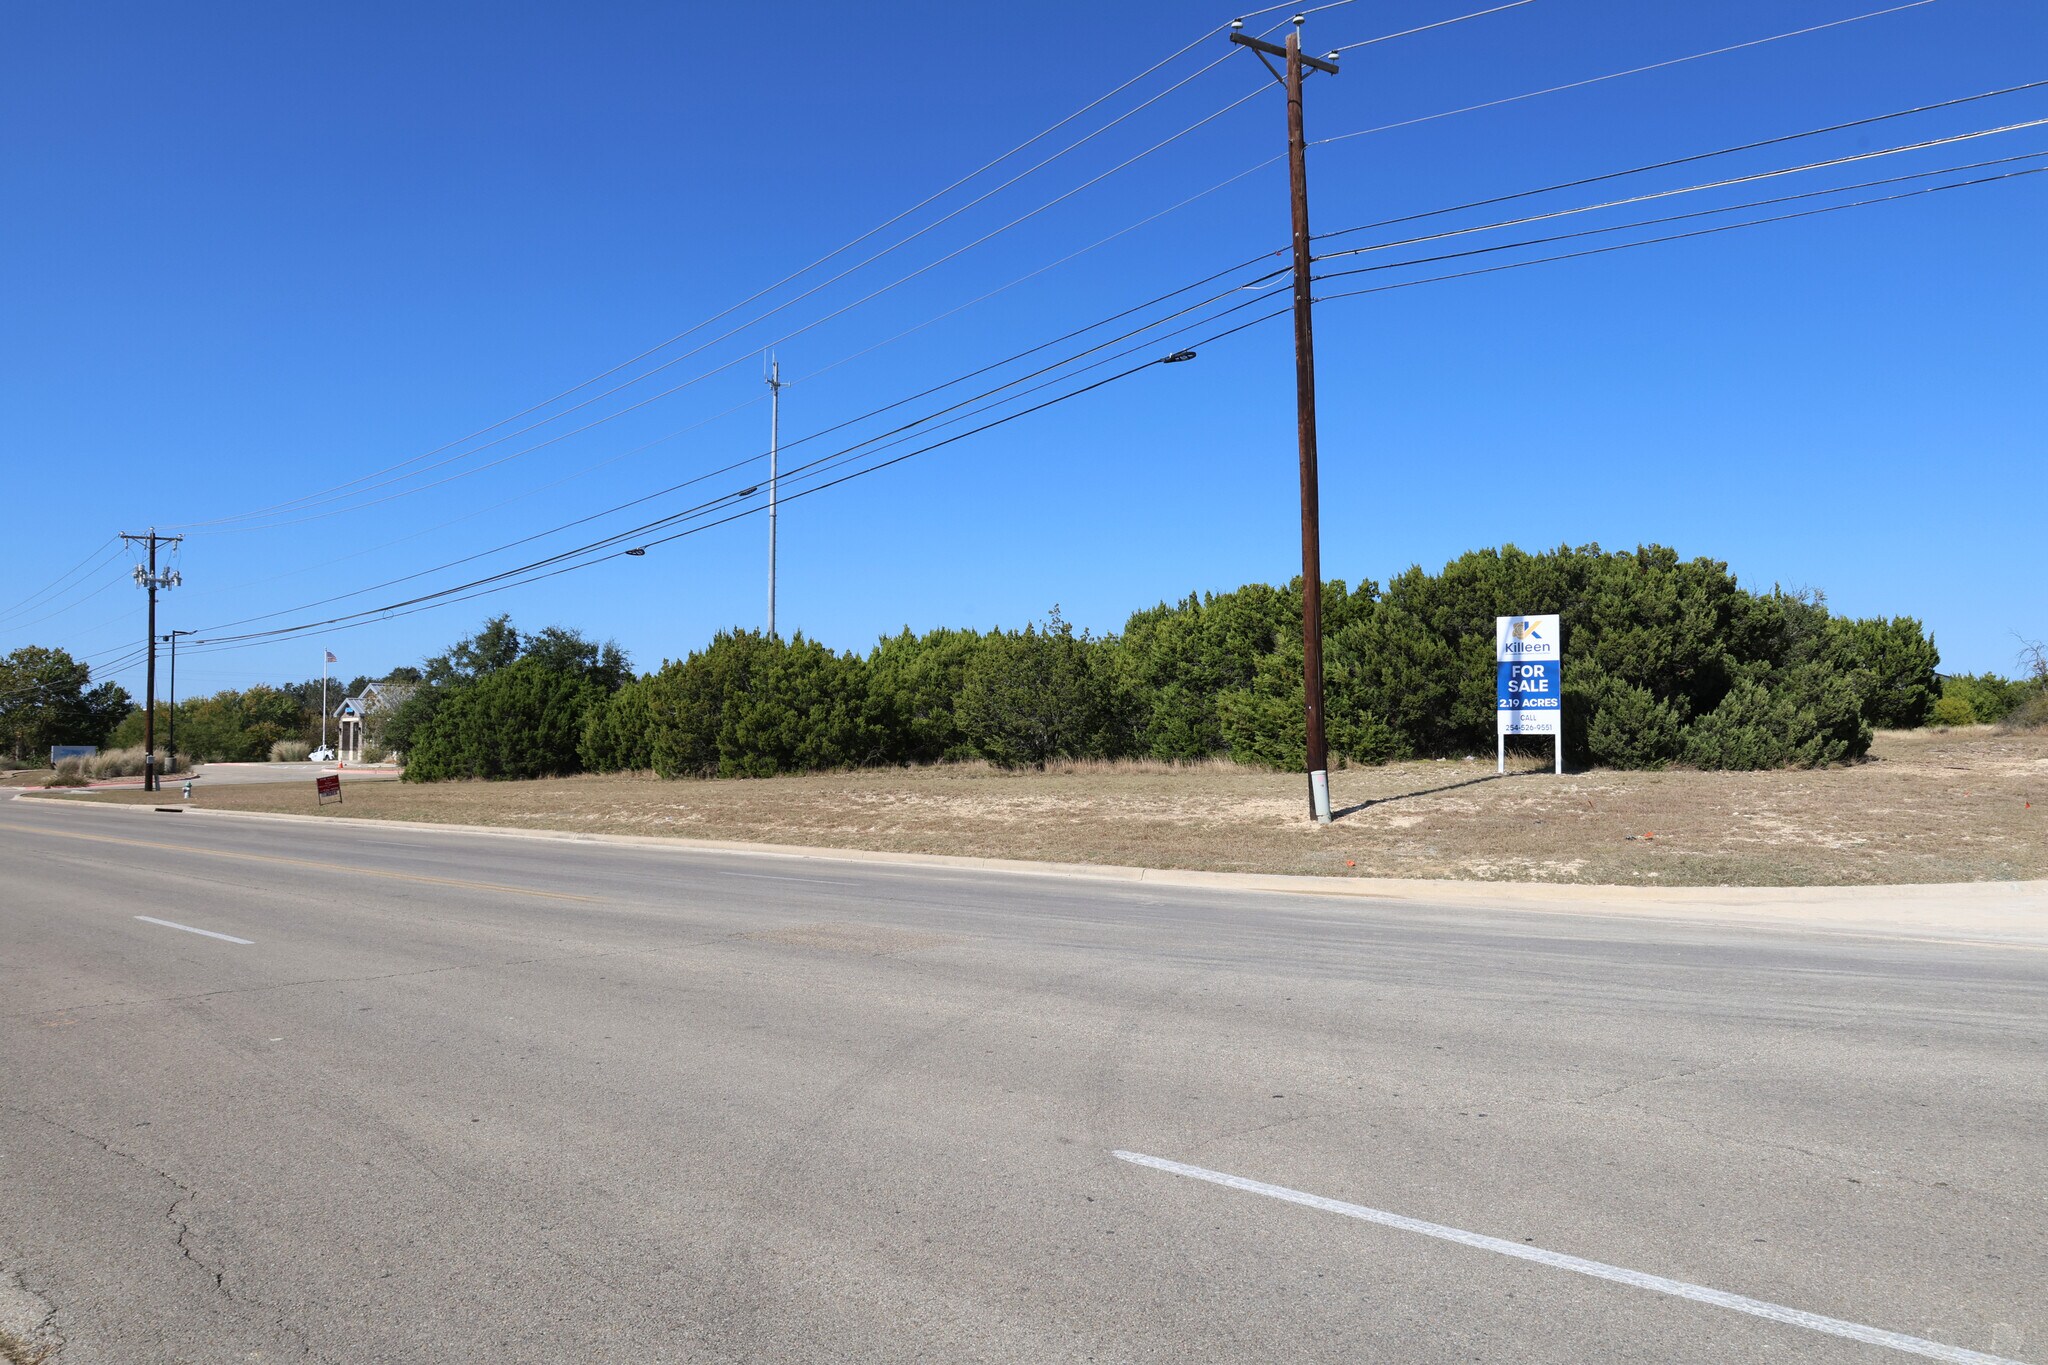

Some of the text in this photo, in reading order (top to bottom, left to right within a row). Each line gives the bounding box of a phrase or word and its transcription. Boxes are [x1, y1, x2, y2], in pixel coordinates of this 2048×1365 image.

[1505, 642, 1550, 653] Killeen
[1512, 665, 1544, 678] FOR
[1508, 679, 1548, 692] SALE
[1500, 698, 1558, 707] 2.19 ACRES
